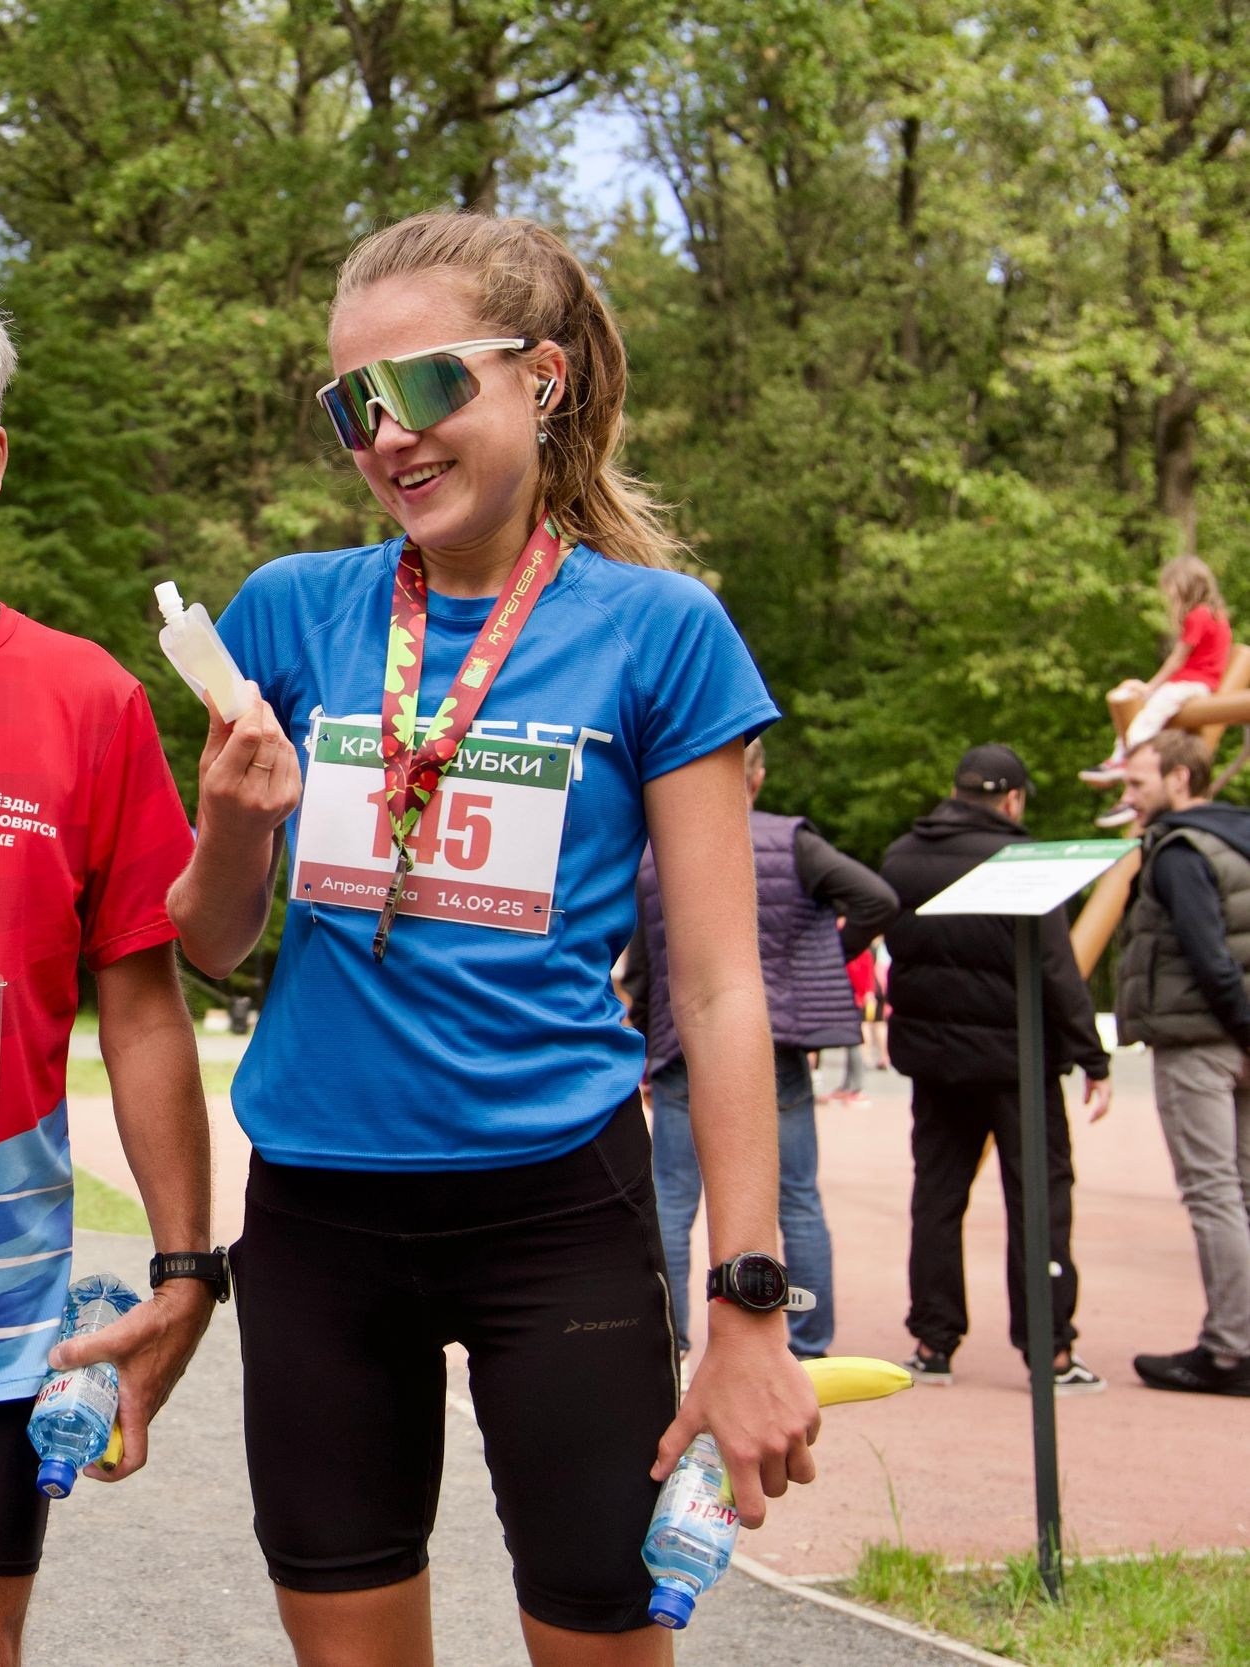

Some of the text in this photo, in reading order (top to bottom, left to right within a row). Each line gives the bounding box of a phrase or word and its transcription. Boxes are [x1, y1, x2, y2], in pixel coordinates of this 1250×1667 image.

[488, 550, 546, 646] АПРЕЛЕВКА
[367, 789, 494, 872] 145
[321, 876, 525, 917] Апрелека 14.09.25
[583, 1317, 640, 1331] DEMIX
